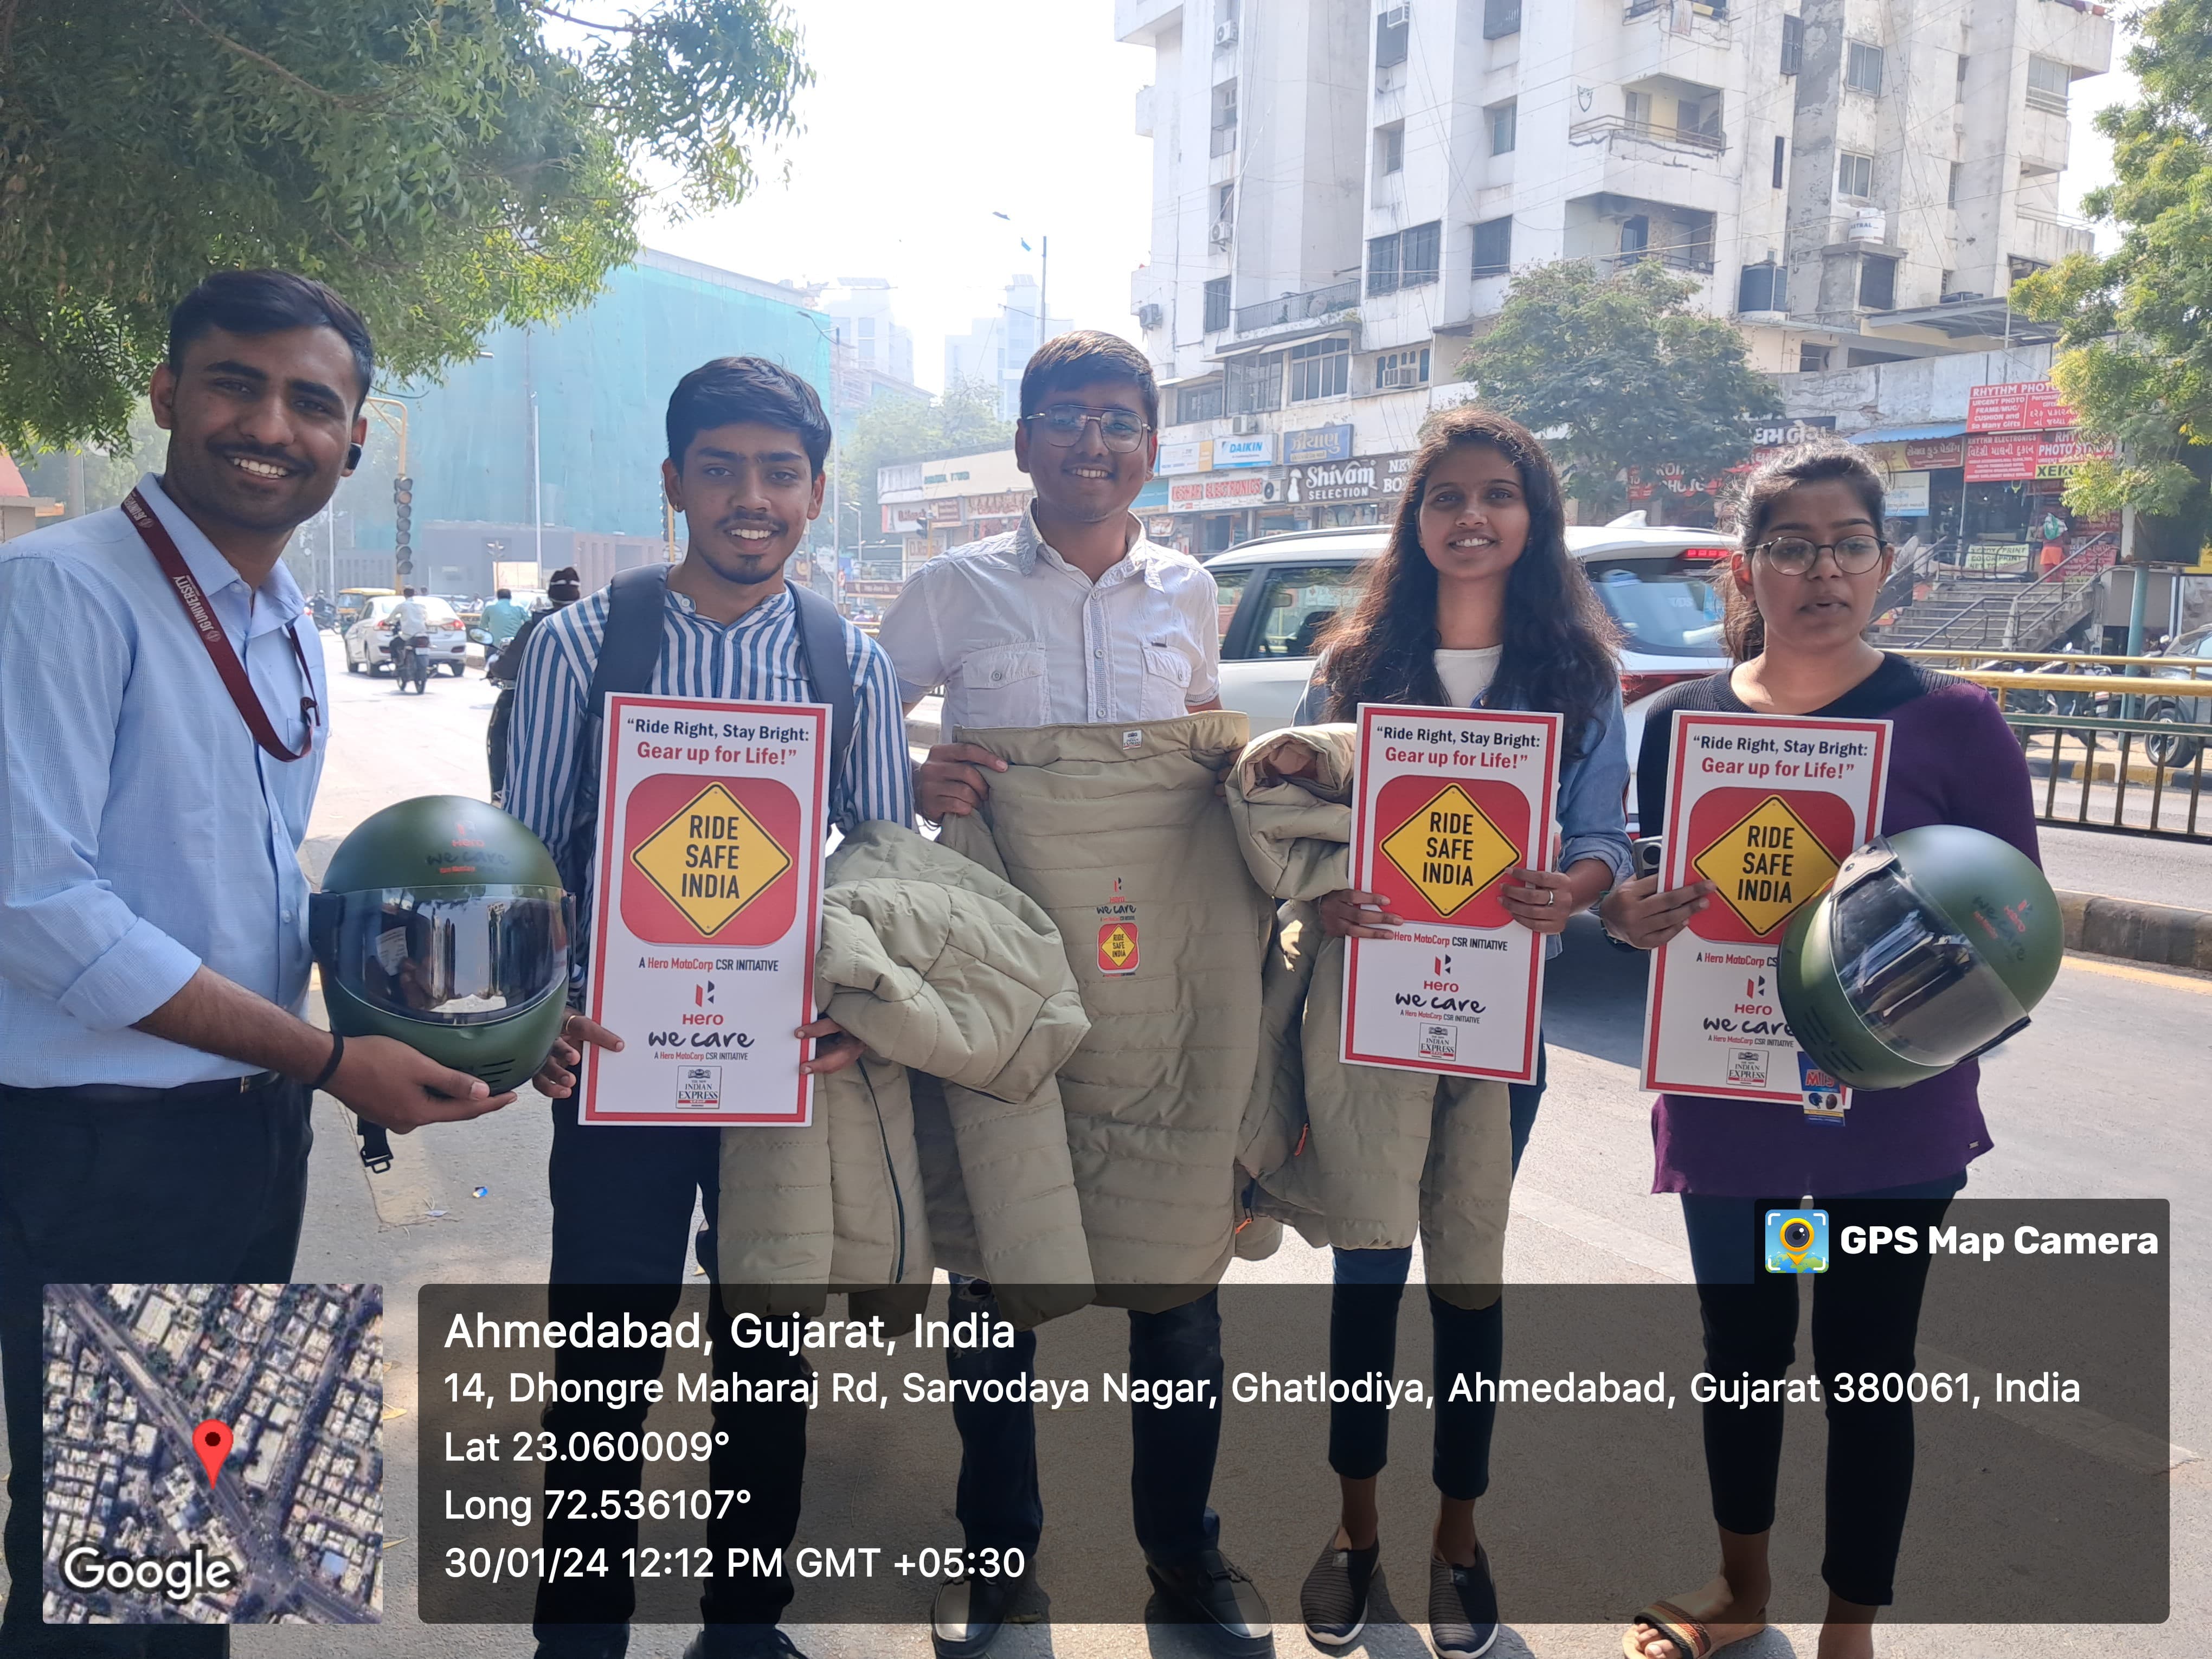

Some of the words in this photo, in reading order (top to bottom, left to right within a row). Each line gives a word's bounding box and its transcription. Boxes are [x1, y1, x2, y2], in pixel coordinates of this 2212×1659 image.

[1973, 384, 2017, 396] RHYTHM
[1974, 414, 2004, 422] CUSHION
[1994, 434, 2036, 443] ELECTRONICS
[1230, 442, 1263, 453] DAIKIN
[2039, 443, 2072, 456] PHOTO
[1306, 460, 1378, 490] Shivam
[1308, 487, 1368, 500] SELECTION
[674, 721, 718, 739] Right,
[723, 724, 756, 741] Stay
[760, 726, 809, 743] Bright:
[1417, 729, 1456, 744] Right,
[1461, 731, 1490, 747] Stay
[1493, 732, 1540, 749] Bright:
[638, 742, 683, 760] Gear
[686, 748, 710, 764] up
[715, 745, 741, 763] for
[745, 748, 797, 765] Life!”
[1737, 737, 1778, 755] Right,
[1784, 740, 1815, 756] Stay
[1818, 741, 1868, 758] Bright:
[1385, 747, 1425, 763] Gear
[1428, 753, 1448, 768] up
[1453, 750, 1477, 767] for
[1480, 753, 1528, 769] Life!”
[1701, 757, 1745, 774] Gear
[1748, 763, 1770, 779] up
[1775, 760, 1800, 777] for
[1804, 762, 1854, 780] Life!”
[689, 815, 740, 840] RIDE
[1430, 811, 1474, 835] RIDE
[452, 839, 485, 847] Hero
[1747, 825, 1795, 850] RIDE
[1426, 837, 1474, 861] SAFE
[426, 852, 459, 865] we
[462, 851, 511, 865] care
[685, 844, 740, 870] SAFE
[1742, 852, 1795, 877] SAFE
[1423, 862, 1474, 886] INDIA
[681, 873, 740, 899] INDIA
[1737, 878, 1792, 903] INDIA
[1096, 905, 1112, 915] we
[1114, 904, 1136, 914] care
[1113, 941, 1125, 949] SAFE
[1394, 931, 1412, 942] Hero
[1414, 933, 1450, 948] MotoCorp
[1452, 937, 1467, 947] CSR
[1469, 938, 1508, 951] INITIATIVE
[1112, 949, 1127, 957] INDIA
[1696, 952, 1702, 962] A
[1705, 953, 1724, 964] Hero
[1725, 954, 1764, 968] MotoCorp
[1766, 957, 1778, 967] CS
[639, 957, 645, 968] A
[648, 958, 669, 969] Hero
[671, 959, 713, 973] MotoCorp
[716, 960, 734, 970] CSR
[736, 960, 779, 972] INITIATIVE
[1424, 980, 1459, 992] Hero
[1396, 992, 1427, 1007] we
[1431, 996, 1487, 1014] care
[1734, 1003, 1772, 1015] Hero
[682, 1014, 724, 1025] Hero
[1418, 1011, 1442, 1020] MotoCorp
[1703, 1017, 1738, 1032] we
[648, 1031, 687, 1047] we
[691, 1031, 755, 1048] care
[1727, 1036, 1753, 1046] MotoCorp
[1421, 1043, 1454, 1053] EXPRESS
[676, 1052, 704, 1062] MotoCorp
[1729, 1069, 1765, 1079] EXPRESS
[679, 1091, 718, 1099] EXPRESS
